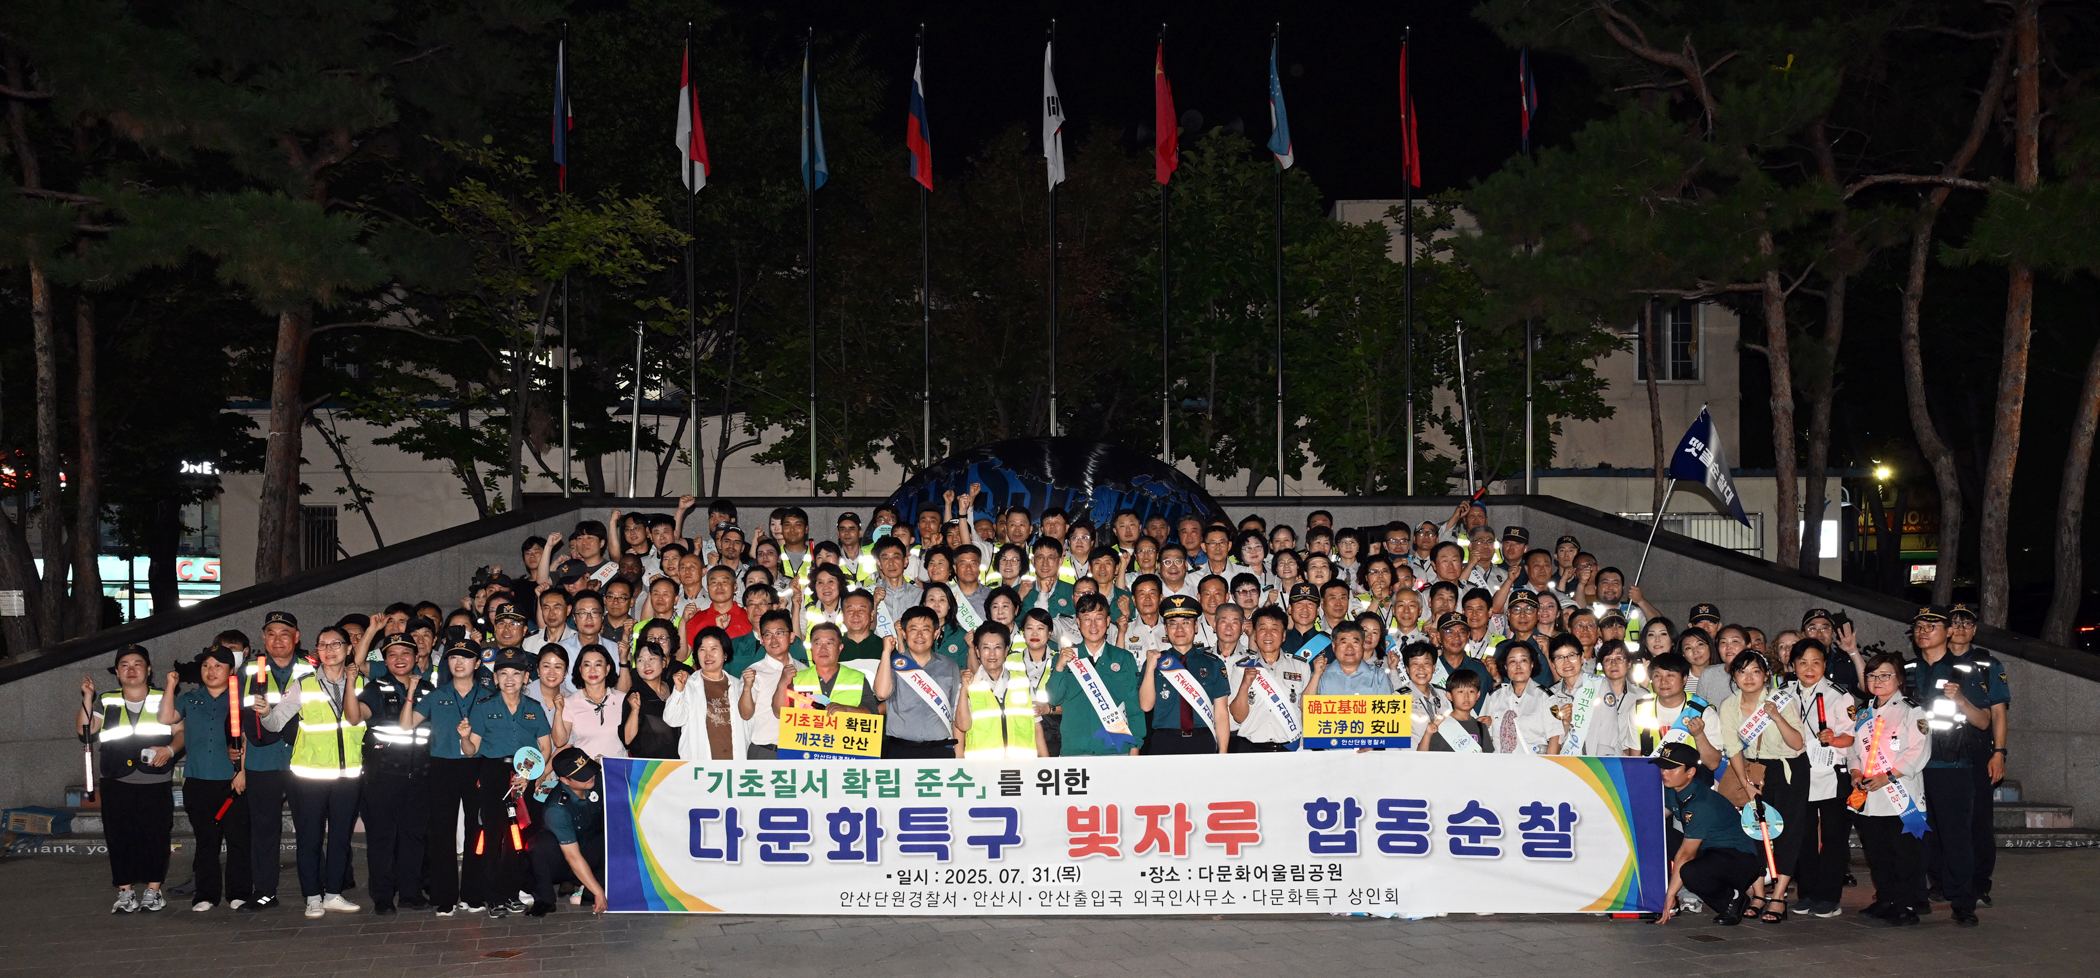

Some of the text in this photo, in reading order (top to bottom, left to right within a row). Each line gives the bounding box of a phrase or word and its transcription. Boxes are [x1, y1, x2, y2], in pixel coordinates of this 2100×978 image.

[1307, 699, 1406, 715] 确立基础 秩序!
[1573, 687, 1595, 729] 깨끗한
[785, 712, 878, 733] 기초질서 확립!
[1317, 719, 1399, 735] 洁净的 安山
[795, 732, 869, 751] 깨끗한 안산
[842, 769, 900, 798] 확립
[1036, 768, 1089, 795] 위한
[689, 797, 1577, 862] 다문화특구 빛자루 합동순찰
[945, 869, 992, 884] 2025.
[999, 869, 1024, 884] 07.
[1033, 866, 1080, 882] 31.(목)
[1199, 863, 1342, 882] 다문화어울림공원
[1039, 890, 1122, 907] 안산출입국
[1348, 888, 1398, 905] 상인회
